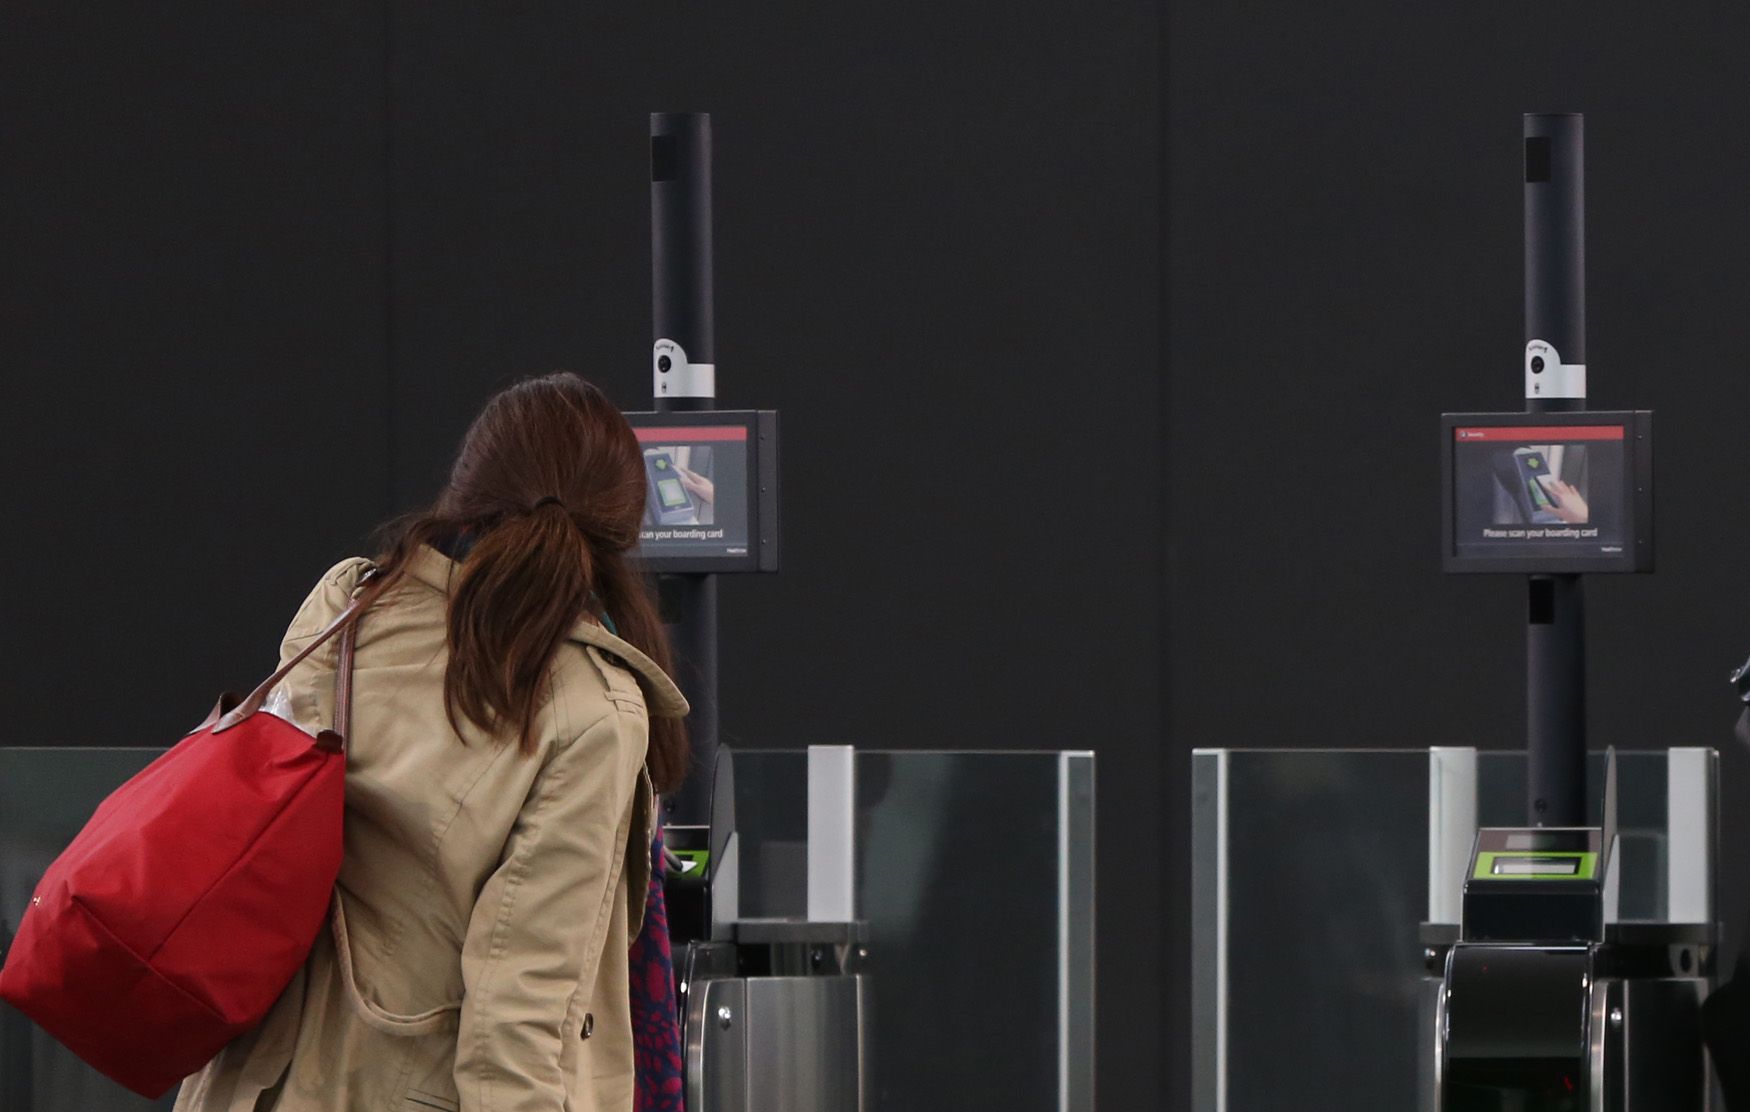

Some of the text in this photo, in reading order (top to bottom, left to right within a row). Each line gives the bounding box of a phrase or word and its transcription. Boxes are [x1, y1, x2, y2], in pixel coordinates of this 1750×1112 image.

[655, 532, 672, 540] your
[673, 530, 706, 540] boarding
[707, 530, 723, 538] card
[1526, 530, 1544, 538] your
[1545, 528, 1580, 538] boarding
